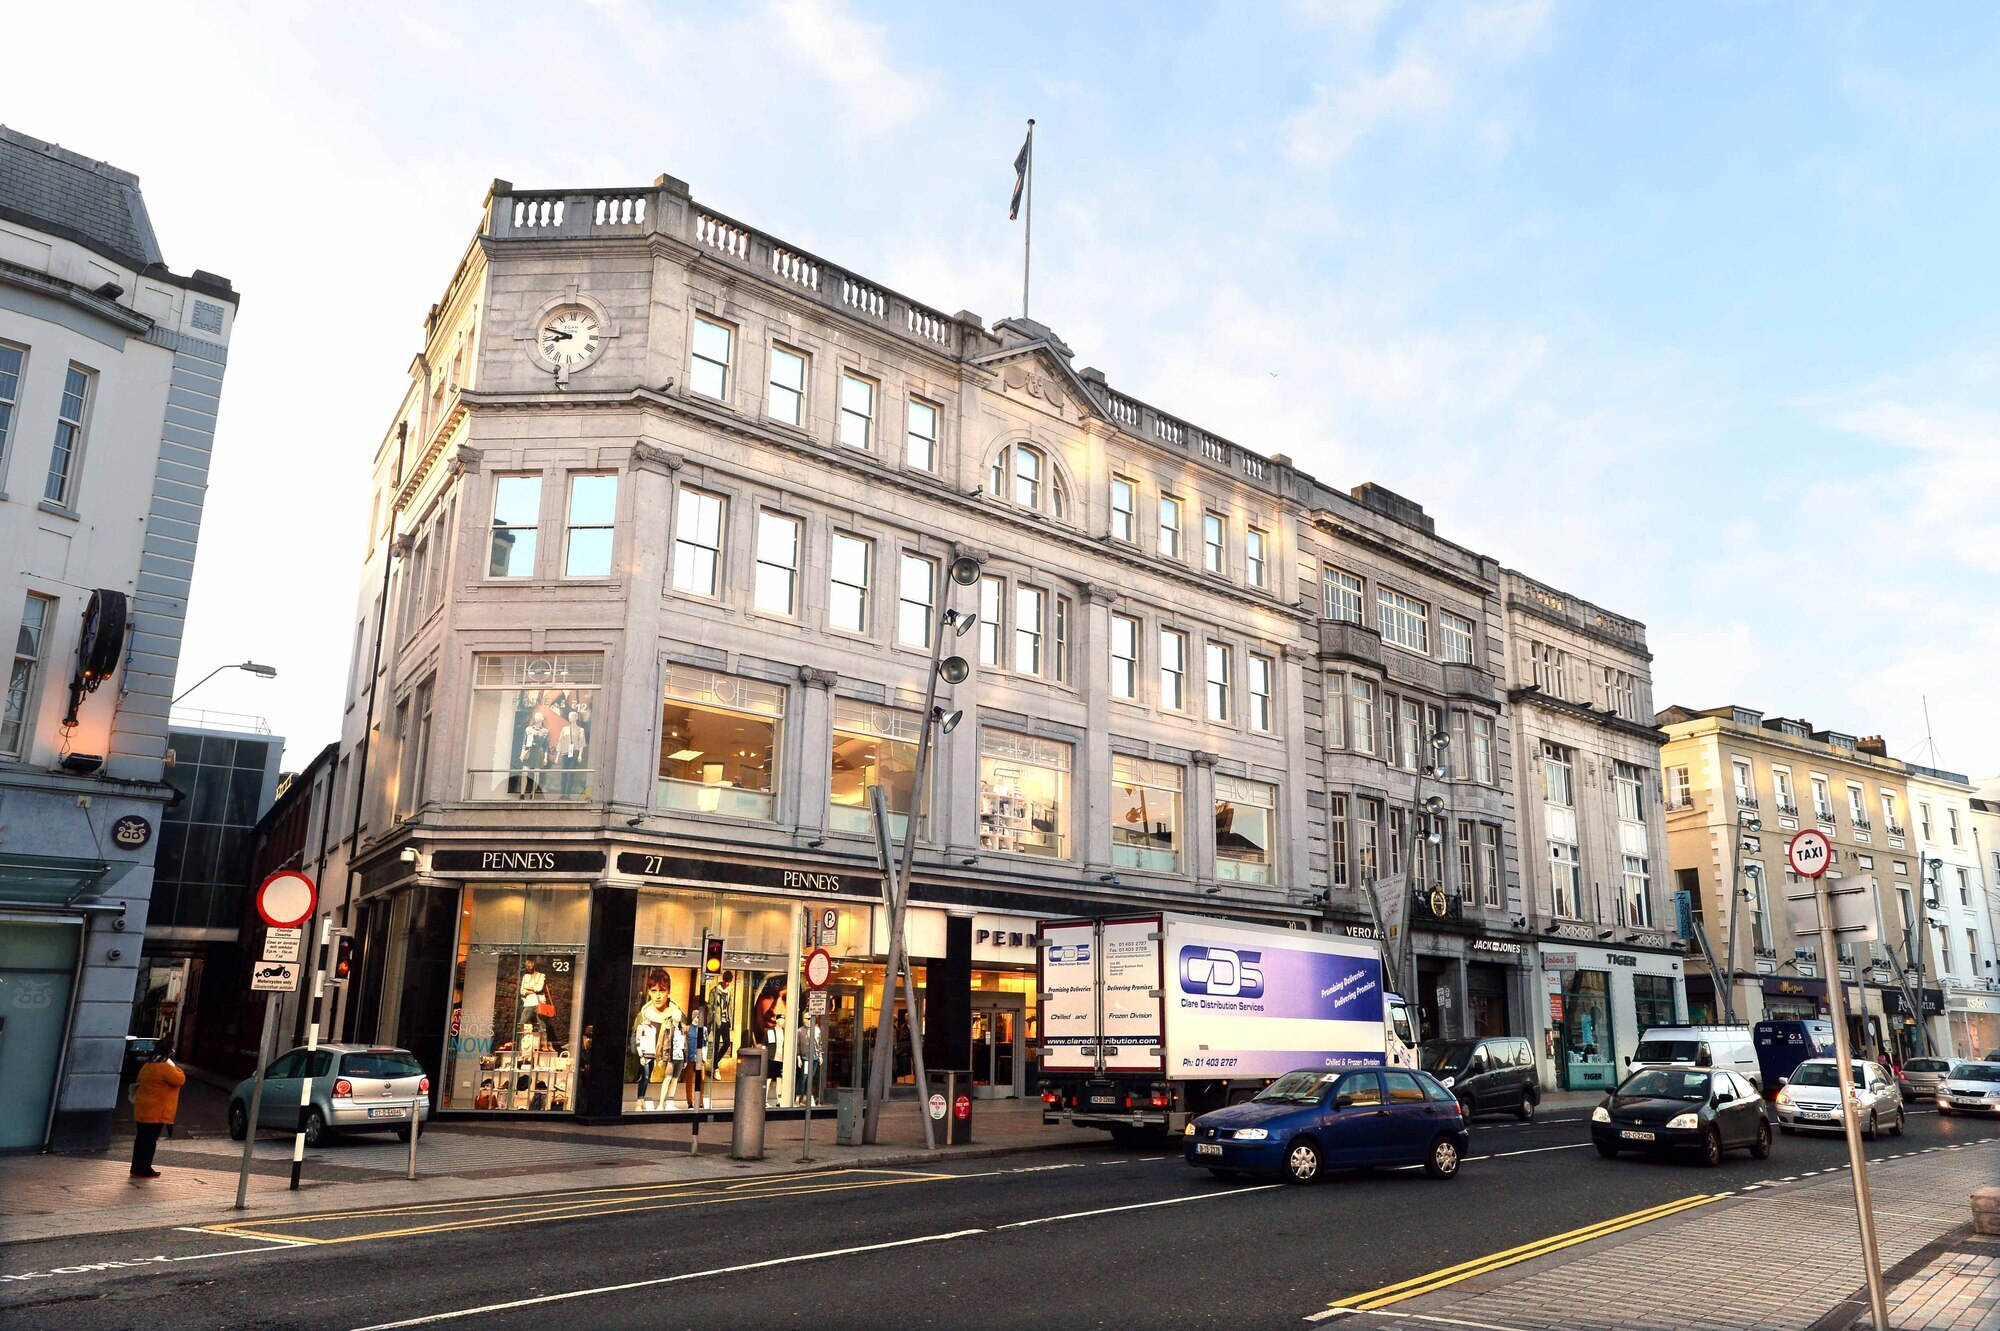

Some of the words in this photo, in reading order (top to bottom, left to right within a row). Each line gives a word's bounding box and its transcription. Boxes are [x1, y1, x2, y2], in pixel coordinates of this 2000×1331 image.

[482, 852, 555, 869] PENNEYS
[1797, 846, 1823, 862] TAXI
[644, 856, 663, 874] 27
[784, 871, 839, 891] PENNEYS
[1346, 926, 1371, 939] VERO
[1049, 944, 1091, 962] CDS
[1474, 940, 1493, 951] JACK
[1499, 942, 1521, 954] JONES
[552, 962, 570, 972] €23
[1606, 953, 1637, 967] TIGER
[1180, 944, 1264, 999] CDS
[1321, 982, 1344, 998] Promising
[1344, 969, 1365, 986] Deliveries
[1334, 990, 1357, 1008] Delivering
[1356, 980, 1376, 996] Promises
[1181, 998, 1198, 1007] Clare
[1200, 1000, 1237, 1010] Distribution
[1239, 1002, 1264, 1011] Services
[450, 1023, 495, 1037] SHOES
[449, 1036, 495, 1053] NOW
[1047, 1038, 1157, 1046] www.claredisribution.com
[1183, 1058, 1193, 1067] Ph:
[1195, 1058, 1204, 1067] 01
[1206, 1058, 1219, 1067] 403
[1220, 1058, 1238, 1067] 2727
[1325, 1058, 1341, 1066] Chilled
[1347, 1058, 1362, 1066] Frozen
[1363, 1058, 1380, 1066] Division
